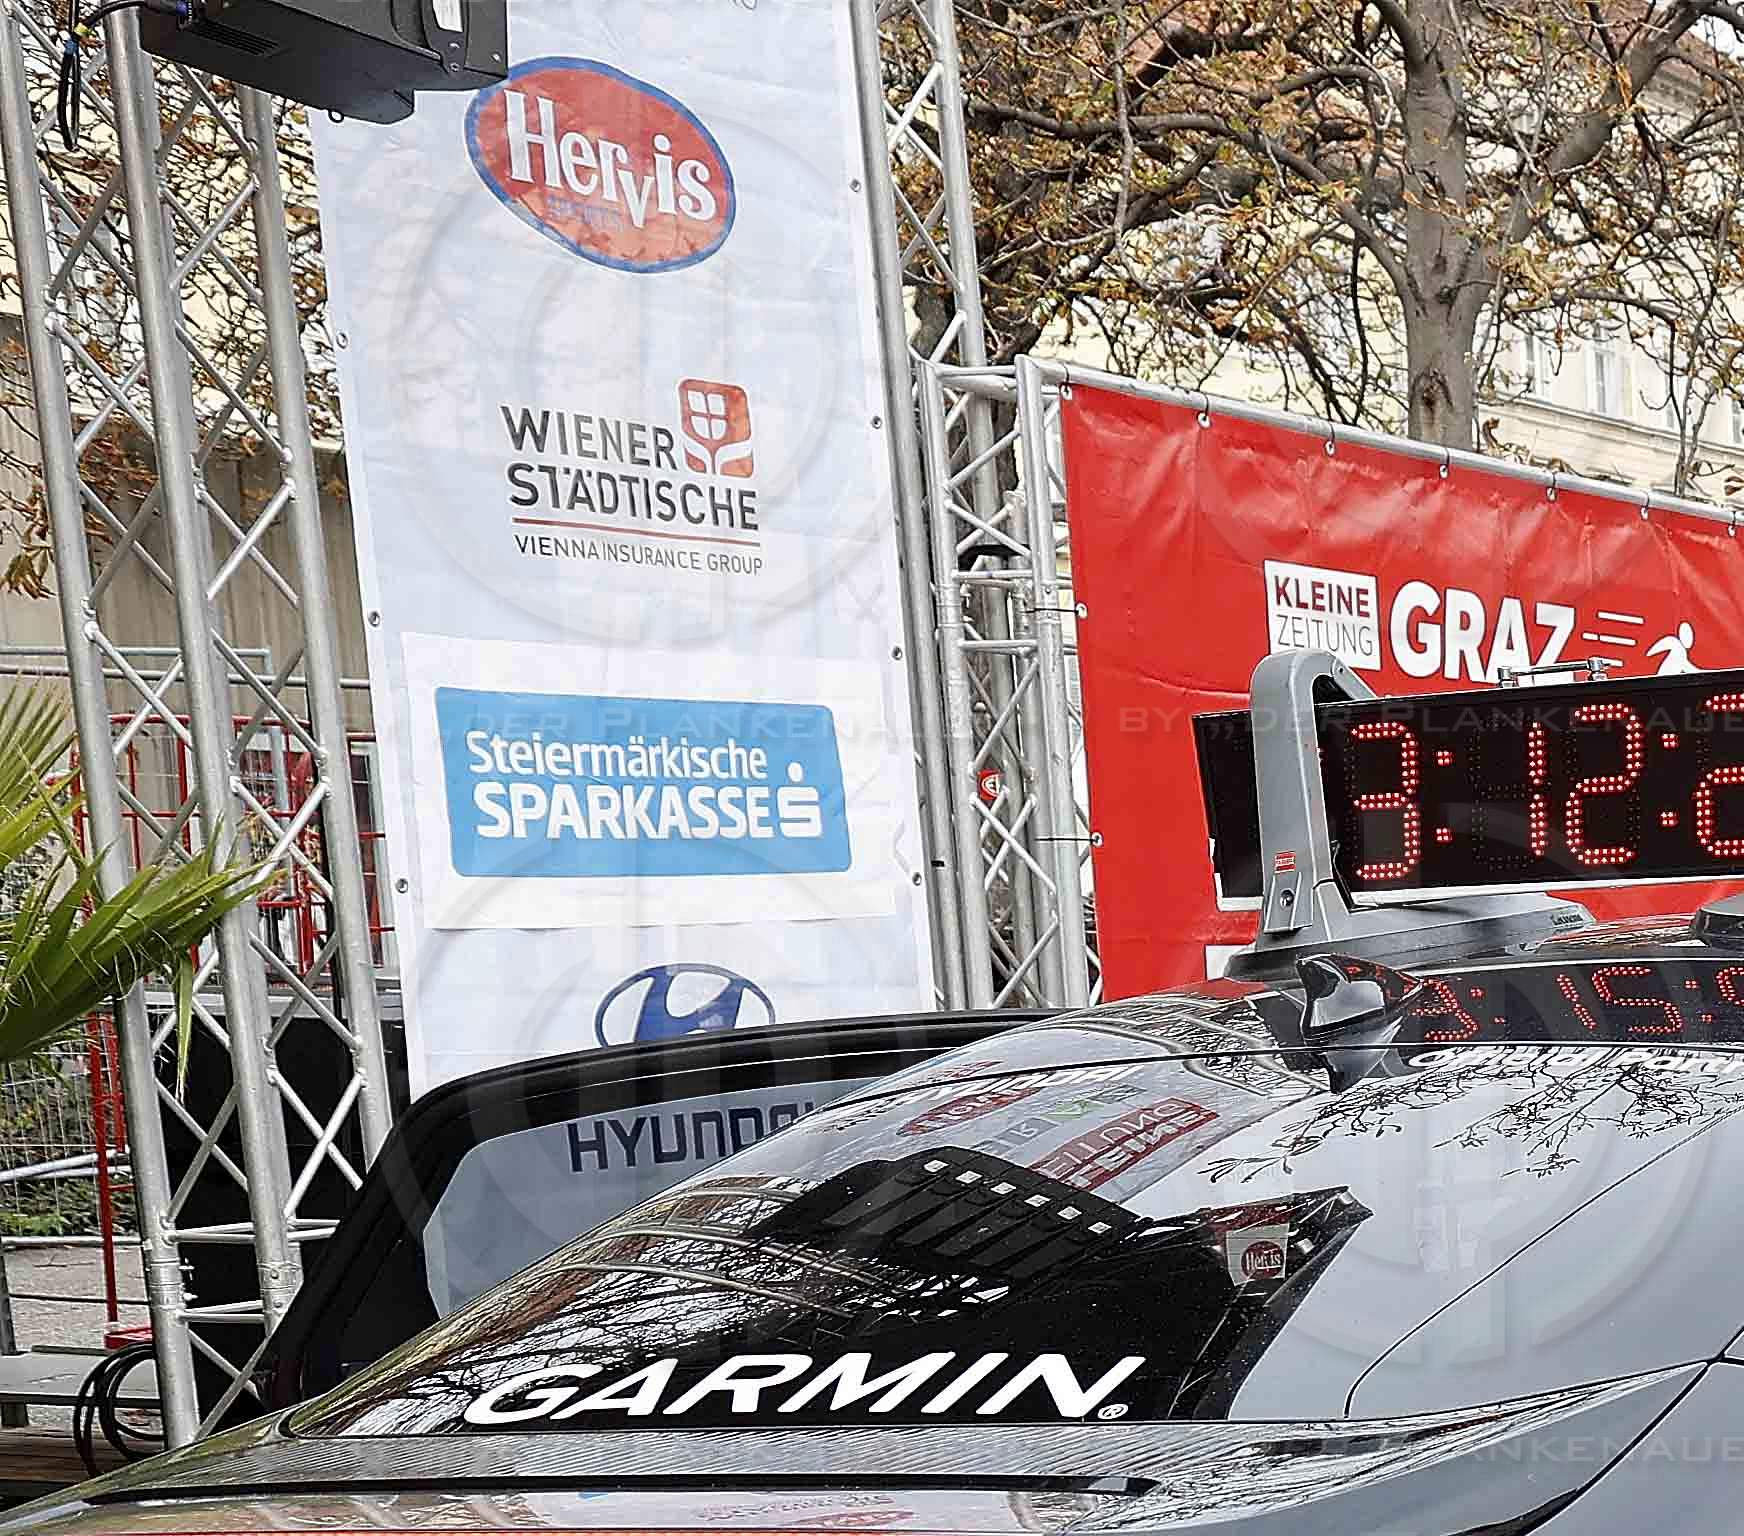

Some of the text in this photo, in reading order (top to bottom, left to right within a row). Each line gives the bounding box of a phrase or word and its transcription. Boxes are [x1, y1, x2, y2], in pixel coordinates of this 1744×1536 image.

[504, 89, 717, 229] Hervis
[500, 405, 678, 471] WIENER
[507, 462, 759, 531] STÄDTISCHE
[514, 534, 763, 576] VIENNA INSURANCE GROUP
[1273, 575, 1371, 618] KLEINE
[1276, 613, 1374, 658] ZEITUNG
[1390, 580, 1577, 685] GRAZ
[466, 730, 767, 779] Steiermärkische
[474, 781, 774, 839] SPARKASSE
